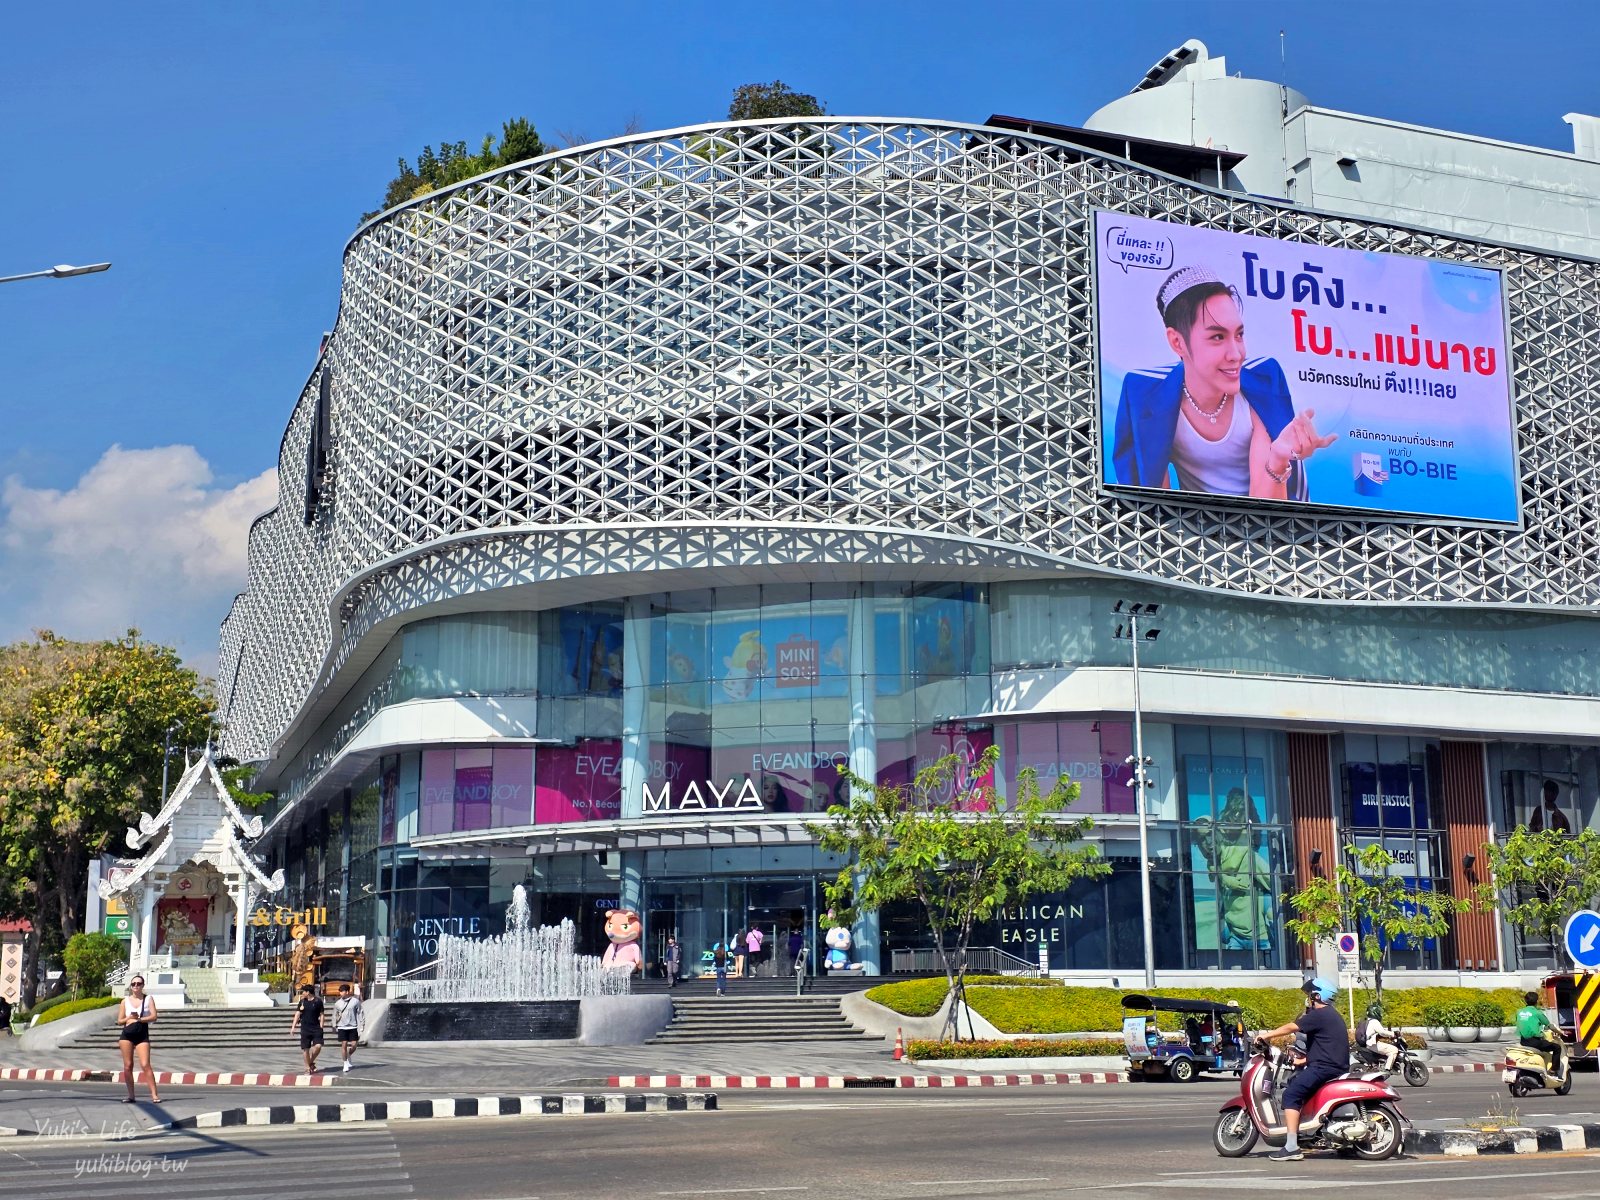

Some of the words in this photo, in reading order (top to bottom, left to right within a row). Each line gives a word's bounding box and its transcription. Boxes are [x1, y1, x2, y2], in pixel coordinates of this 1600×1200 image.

[1120, 251, 1163, 265] ของจริง
[1298, 367, 1381, 391] นวัตกรรมใหม่
[1389, 458, 1458, 481] BO-BIE
[780, 647, 815, 664] MINI
[642, 778, 763, 811] MAYA
[275, 907, 327, 926] Grill
[413, 917, 480, 937] GENTLE
[1002, 928, 1060, 943] EAGLE
